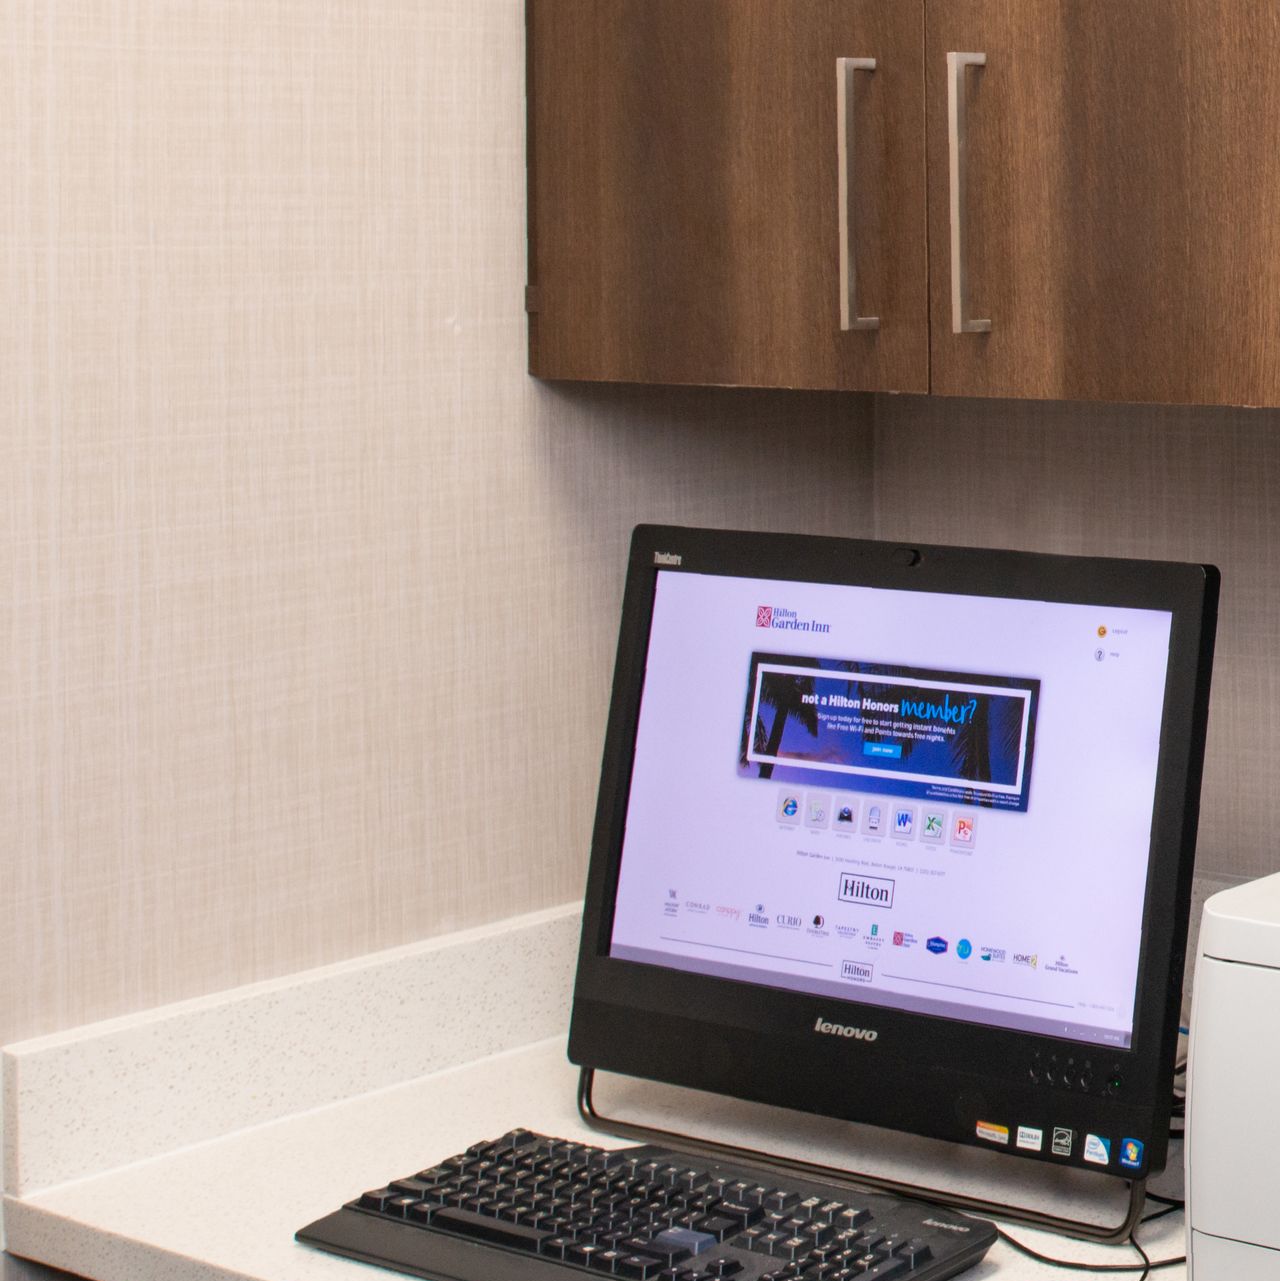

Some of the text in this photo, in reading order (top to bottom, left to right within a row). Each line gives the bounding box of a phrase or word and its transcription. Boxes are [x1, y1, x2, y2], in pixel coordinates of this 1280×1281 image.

[773, 607, 797, 618] Hilton
[771, 617, 830, 633] Garden Inn
[802, 694, 977, 725] not a Hilton Honors member?
[843, 878, 889, 902] Hilton
[748, 913, 769, 925] Hilton
[844, 963, 870, 977] Hilton
[815, 1017, 878, 1041] lenovo
